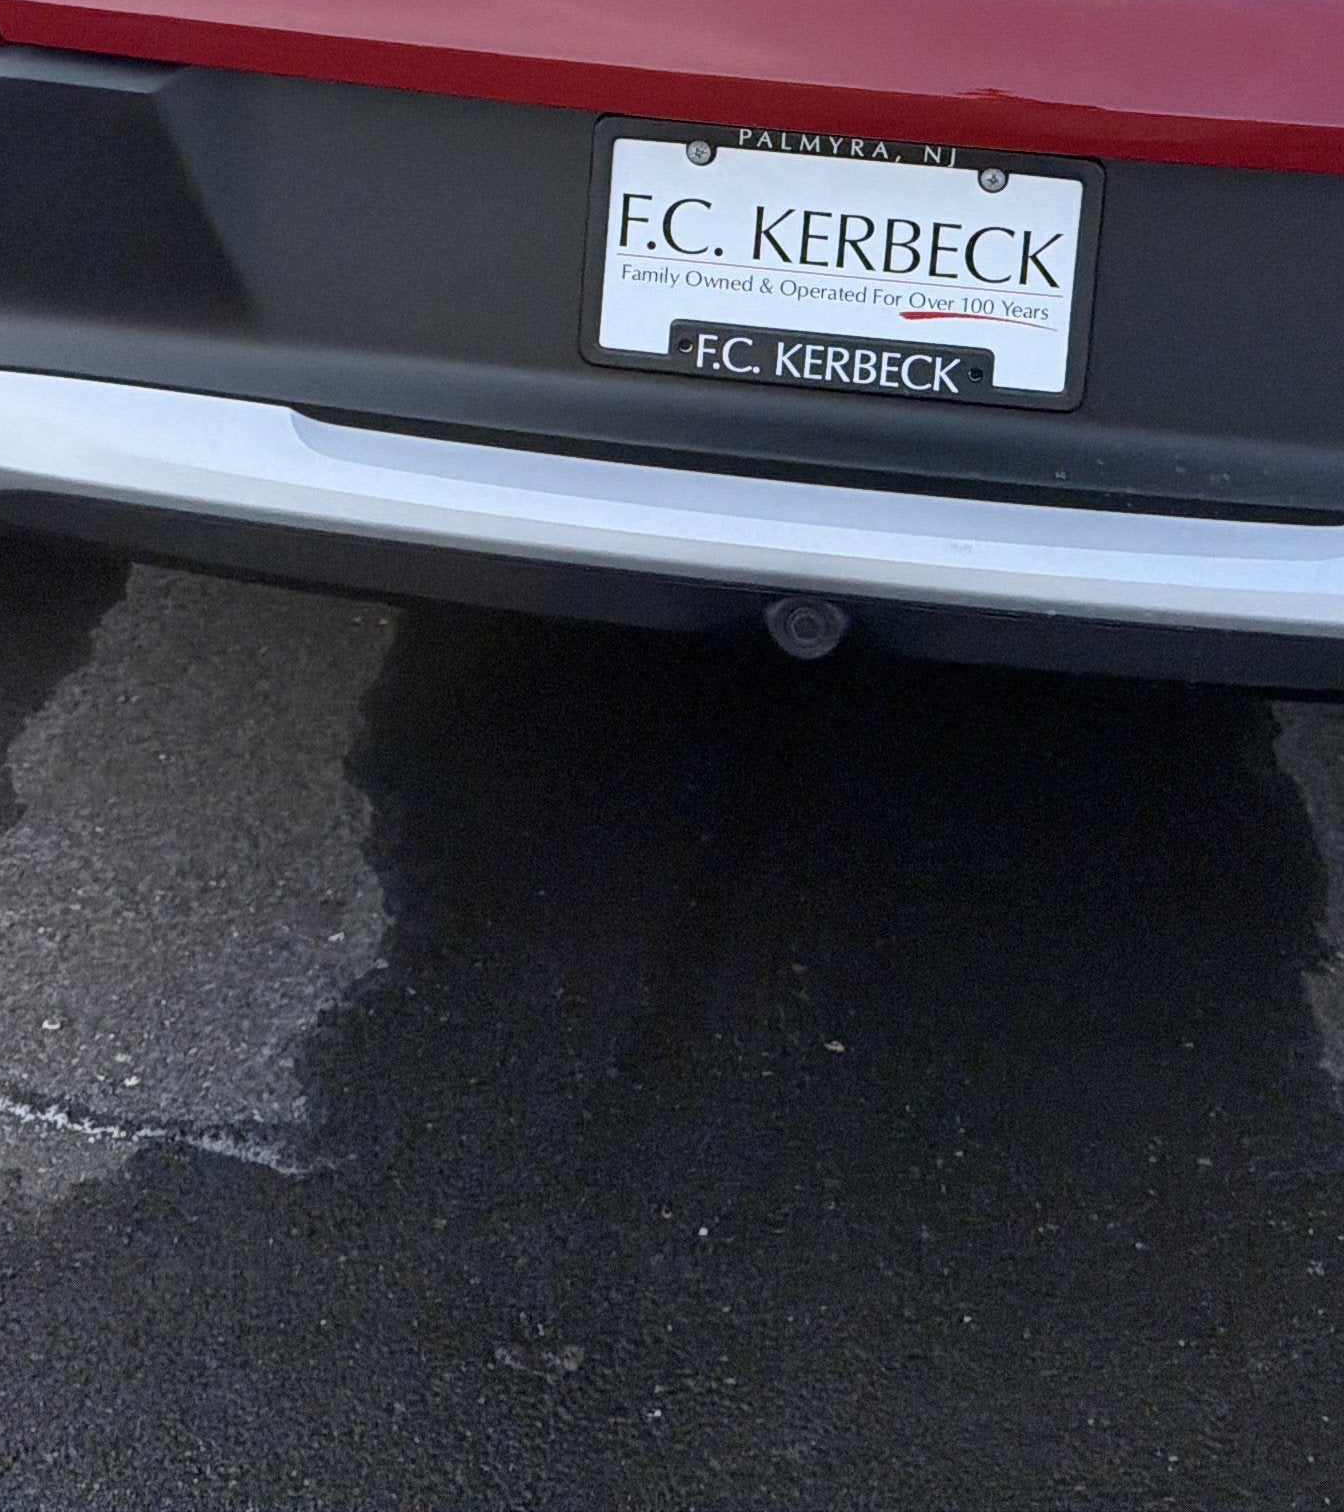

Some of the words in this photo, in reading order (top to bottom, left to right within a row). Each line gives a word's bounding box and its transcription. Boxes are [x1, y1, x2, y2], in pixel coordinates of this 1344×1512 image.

[739, 128, 901, 164] PALMYRA,
[923, 145, 956, 168] NJ
[619, 193, 723, 257] F.C.
[753, 206, 1064, 288] KERBECK
[622, 264, 680, 288] Family
[685, 270, 753, 292] Owned
[759, 278, 773, 294] &
[780, 279, 867, 303] Operated
[873, 288, 902, 307] For
[909, 291, 955, 311] Over
[962, 297, 994, 314] 100
[1002, 300, 1049, 320] Years
[696, 333, 760, 374] F.C.
[775, 342, 961, 393] KERBECK
